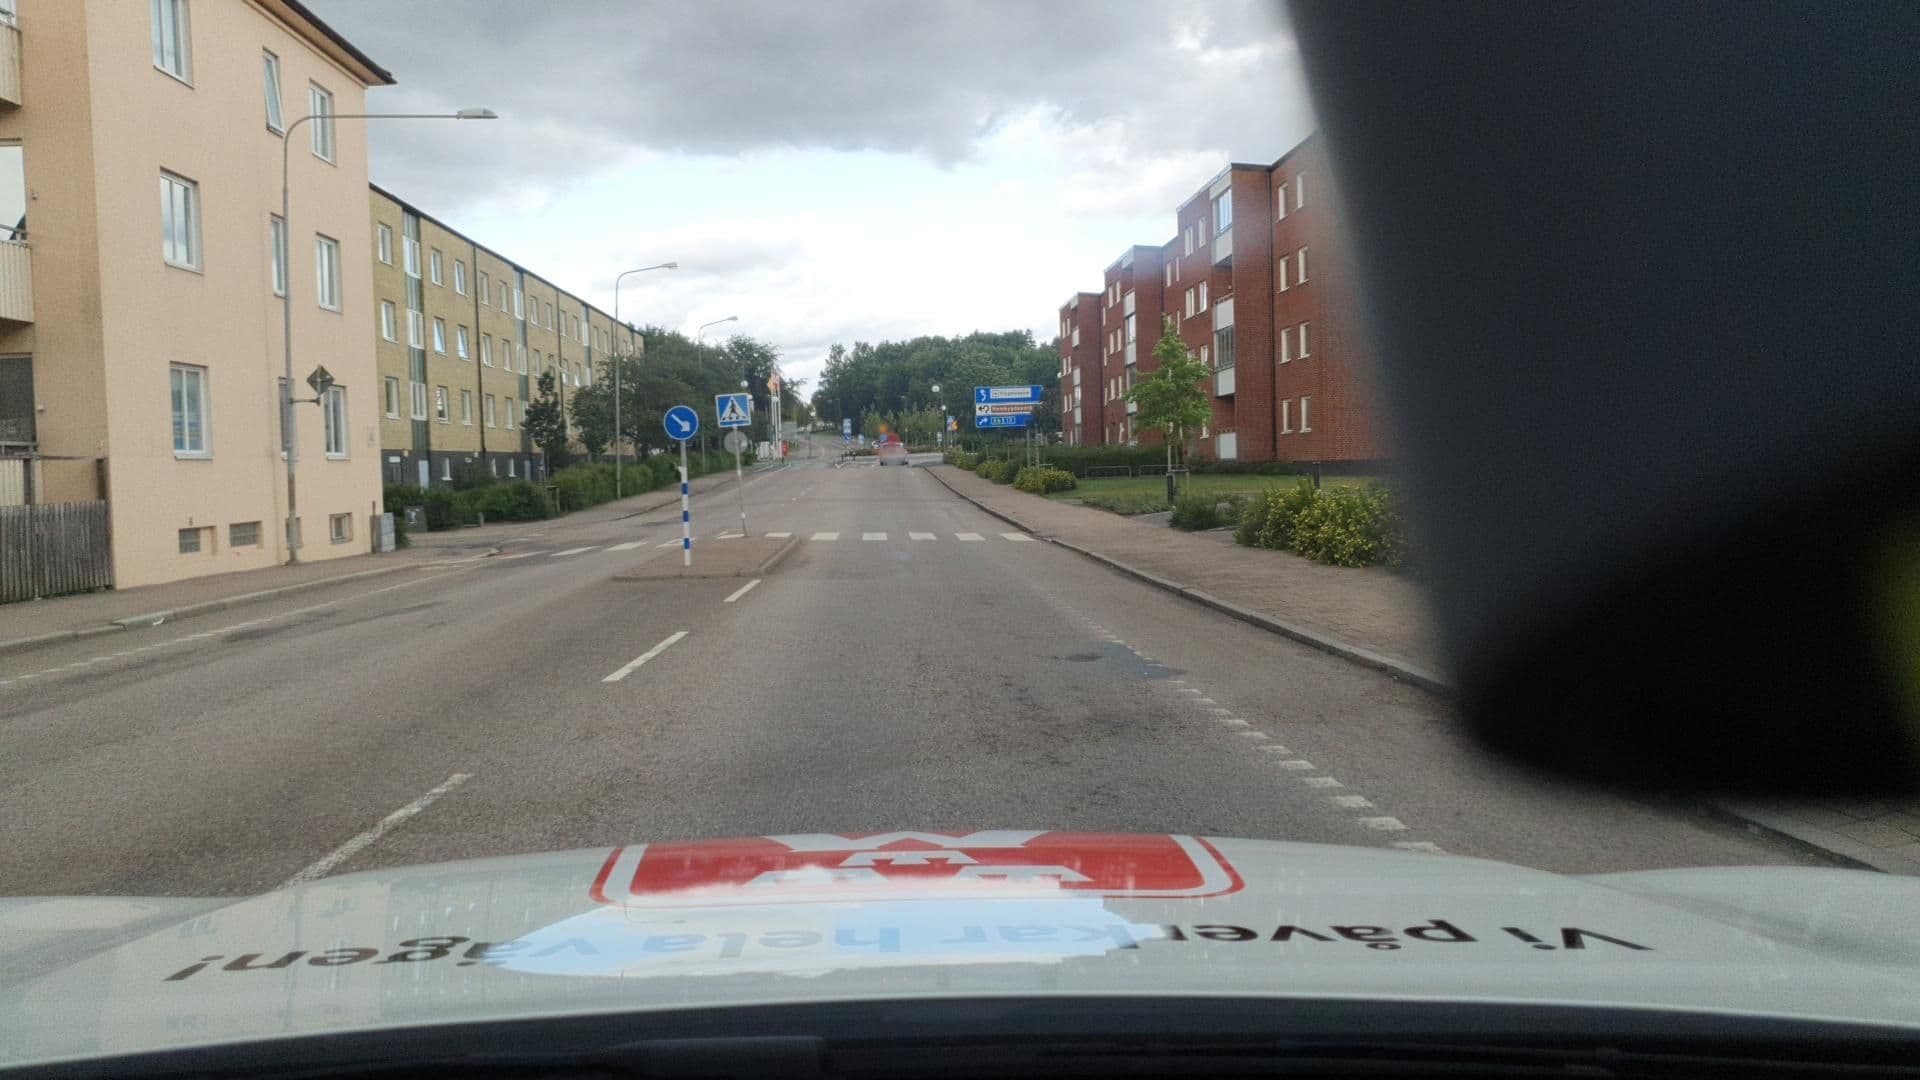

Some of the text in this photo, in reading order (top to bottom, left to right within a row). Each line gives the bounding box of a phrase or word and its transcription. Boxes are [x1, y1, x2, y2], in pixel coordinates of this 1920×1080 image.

[162, 919, 1656, 982] Vi påverkar hela vägen!
